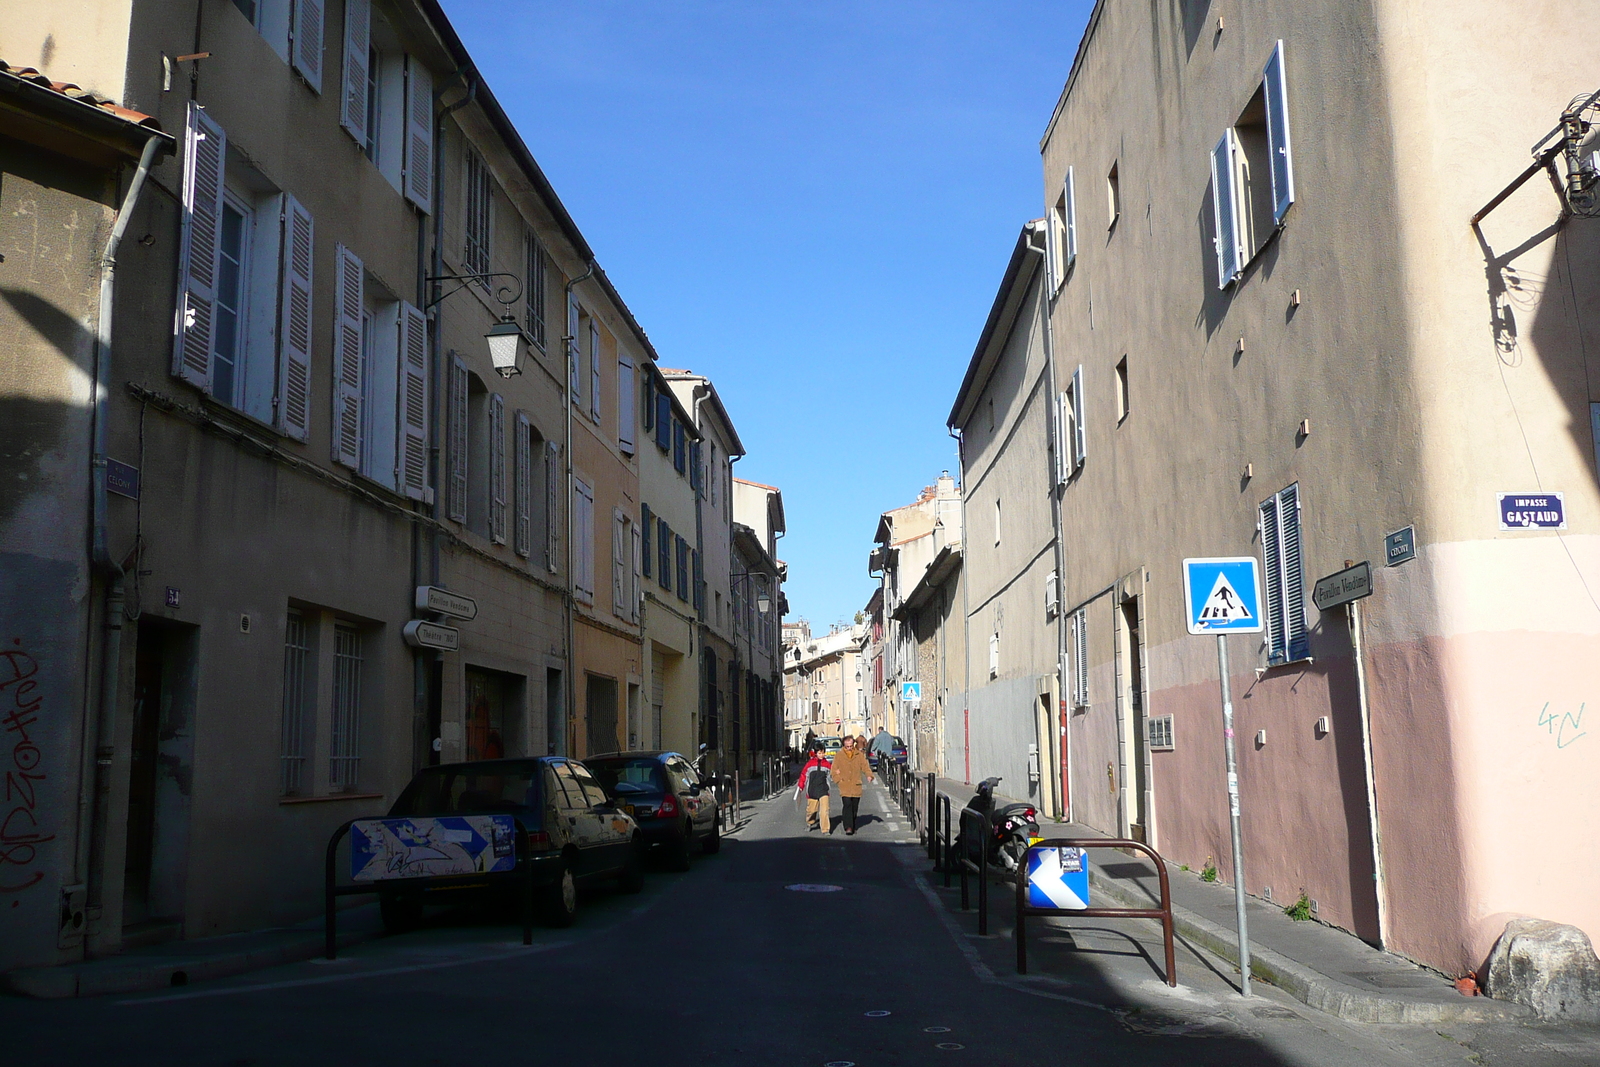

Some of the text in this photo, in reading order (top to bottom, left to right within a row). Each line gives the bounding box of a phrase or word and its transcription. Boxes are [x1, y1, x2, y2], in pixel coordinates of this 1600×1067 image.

[1514, 498, 1548, 507] IMPASSE
[1506, 510, 1559, 523] GASTAUD
[168, 588, 179, 605] 54
[1319, 582, 1341, 602] Pavillon
[430, 594, 450, 607] Pavillon
